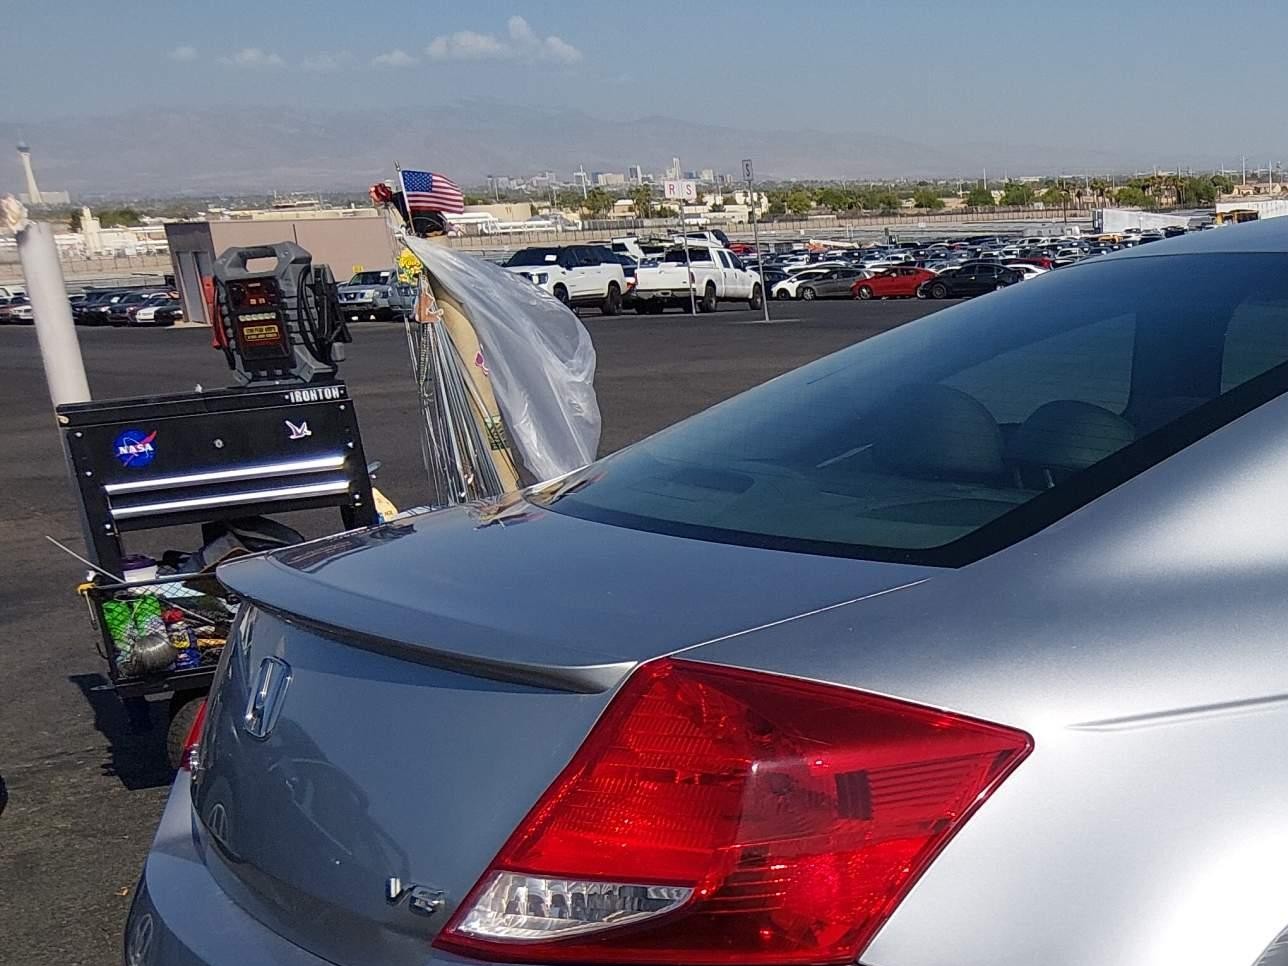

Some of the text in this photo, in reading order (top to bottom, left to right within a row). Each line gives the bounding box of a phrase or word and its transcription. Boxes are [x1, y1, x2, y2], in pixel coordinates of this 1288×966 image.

[289, 387, 340, 403] IRONTON
[118, 443, 154, 455] NASA
[385, 876, 446, 912] V6
